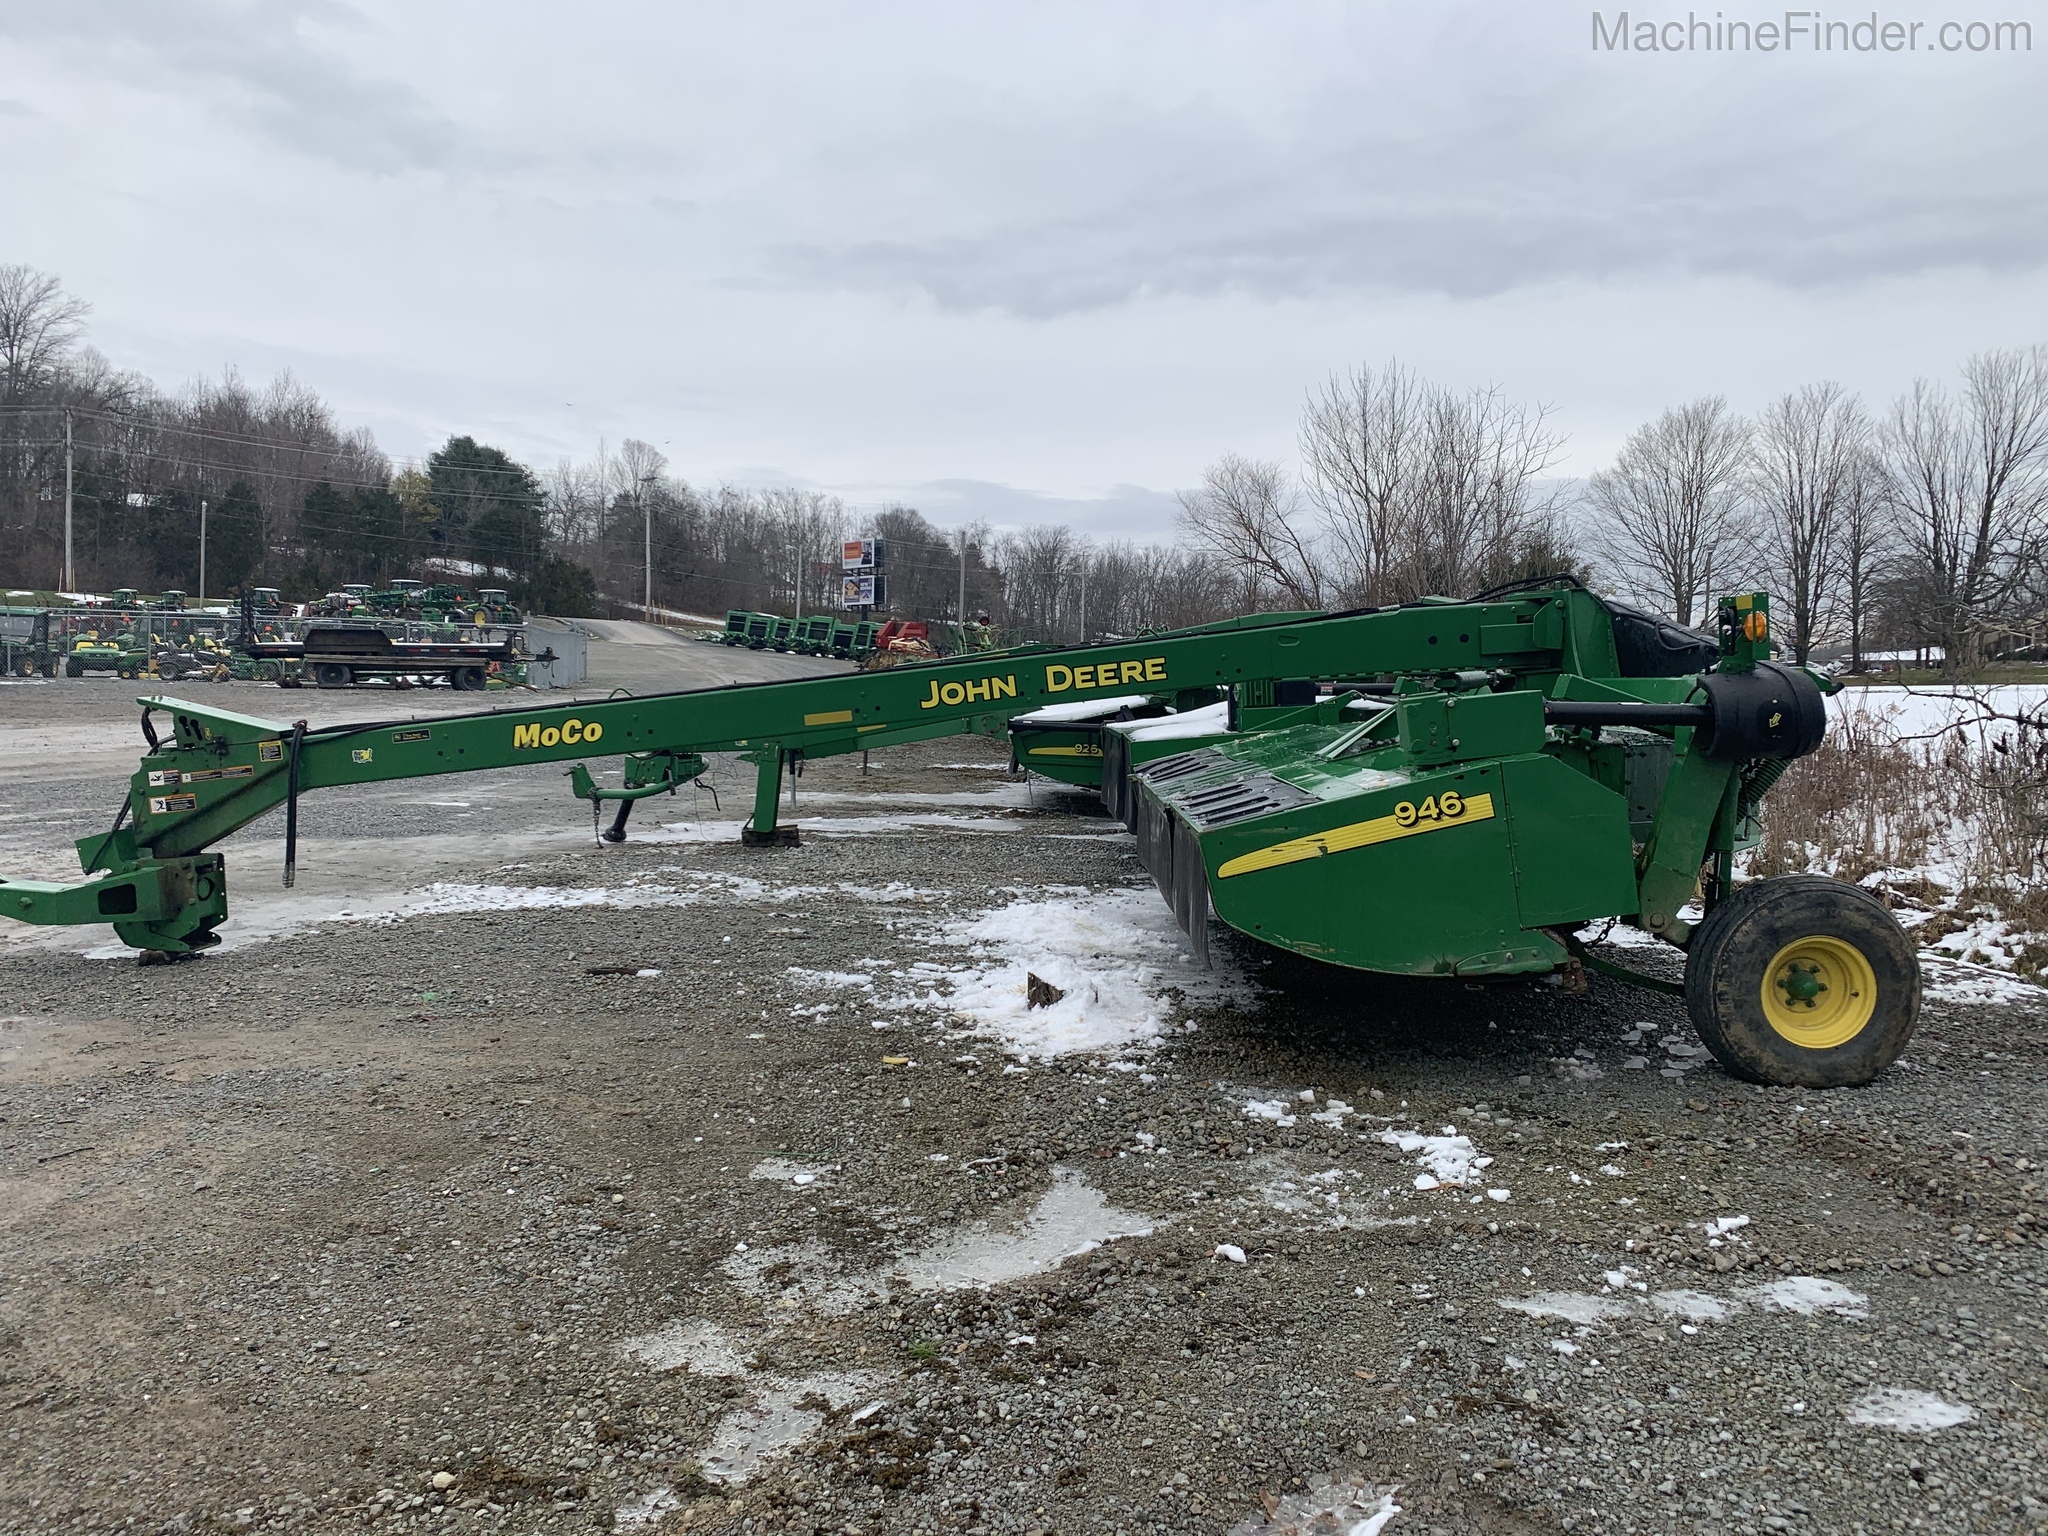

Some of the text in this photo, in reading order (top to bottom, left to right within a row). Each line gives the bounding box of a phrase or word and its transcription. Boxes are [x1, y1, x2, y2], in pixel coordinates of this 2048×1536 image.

[919, 656, 1168, 709] JOHN DEERE
[512, 717, 604, 749] MoCo
[1074, 742, 1099, 755] 926
[1393, 789, 1465, 827] 946
